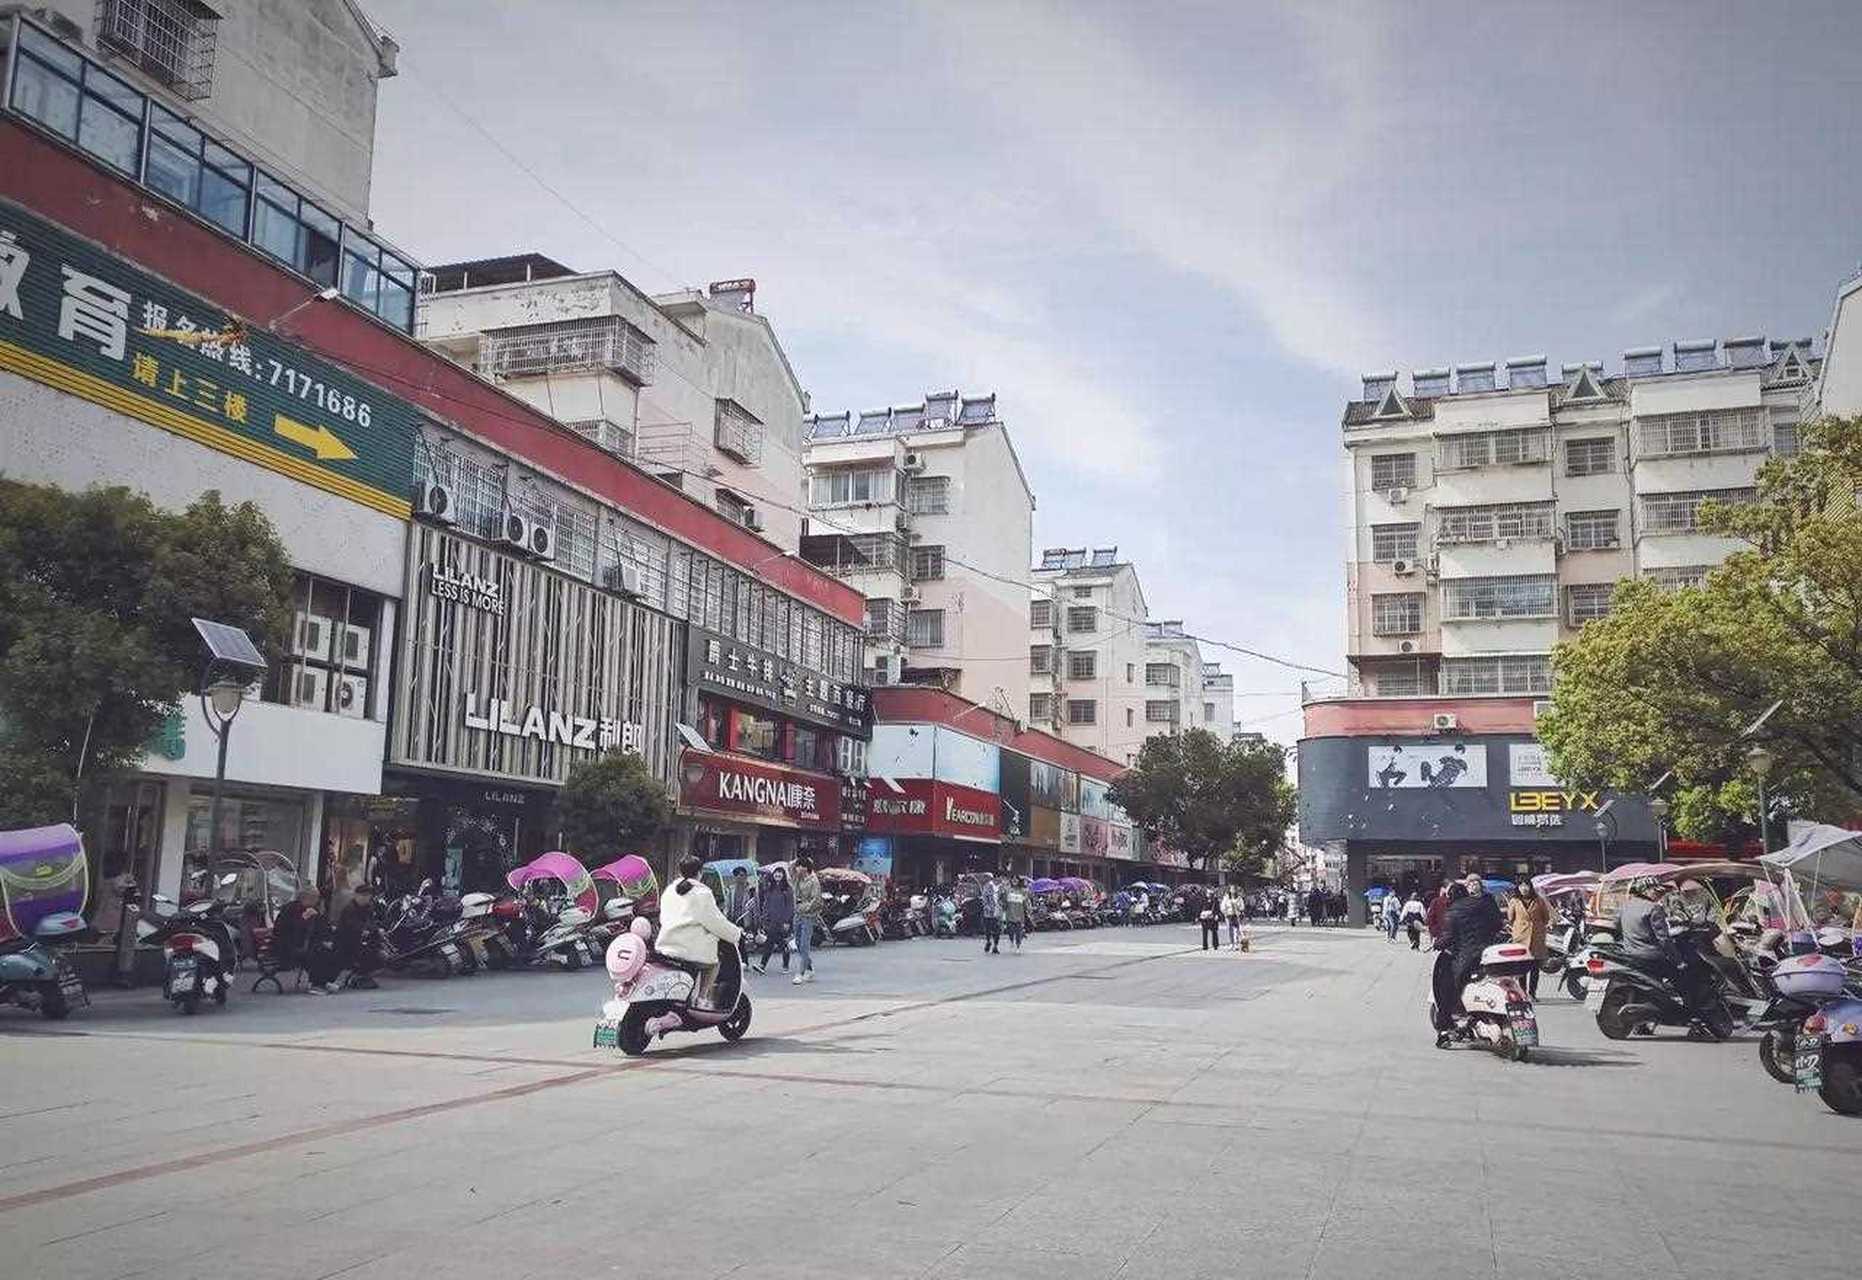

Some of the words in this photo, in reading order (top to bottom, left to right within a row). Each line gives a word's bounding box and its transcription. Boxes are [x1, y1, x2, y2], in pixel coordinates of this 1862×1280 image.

[132, 352, 248, 424] 请上三楼
[432, 579, 458, 600] LESS
[472, 592, 504, 616] MORE
[433, 565, 499, 598] LILANZ
[464, 692, 597, 750] LILANZ
[719, 771, 790, 807] KANGNAI
